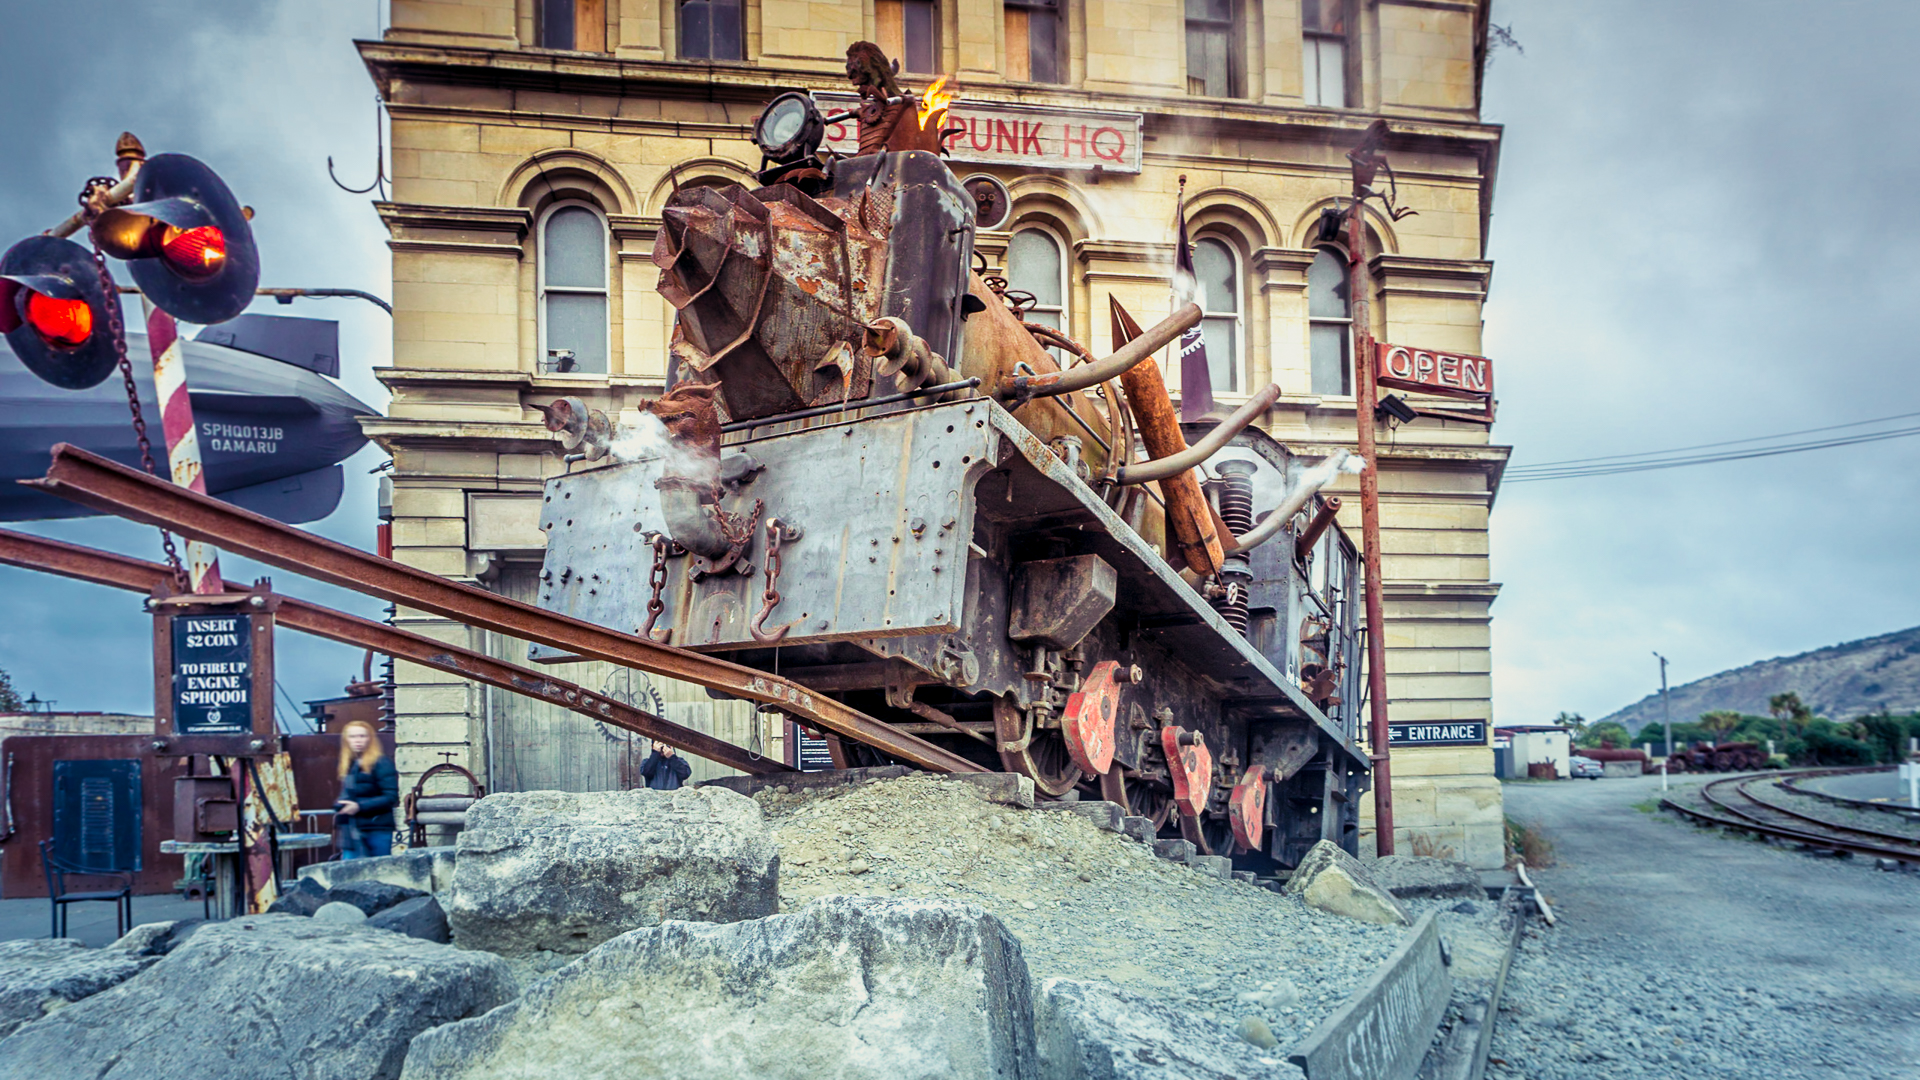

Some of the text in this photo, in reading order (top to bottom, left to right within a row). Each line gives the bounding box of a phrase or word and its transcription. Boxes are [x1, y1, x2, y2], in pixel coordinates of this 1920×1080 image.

[1063, 123, 1125, 163] HQ
[1386, 347, 1486, 390] OPEN
[202, 423, 283, 440] SPHQ013JB
[211, 439, 276, 453] OAMARU
[187, 620, 236, 632] INSERT
[186, 634, 238, 648] $2 COIN
[180, 662, 246, 675] TO FIRE UP
[187, 676, 240, 689] ENGINE
[180, 690, 247, 707] SPHQ001
[1408, 725, 1475, 740] ENTRANCE
